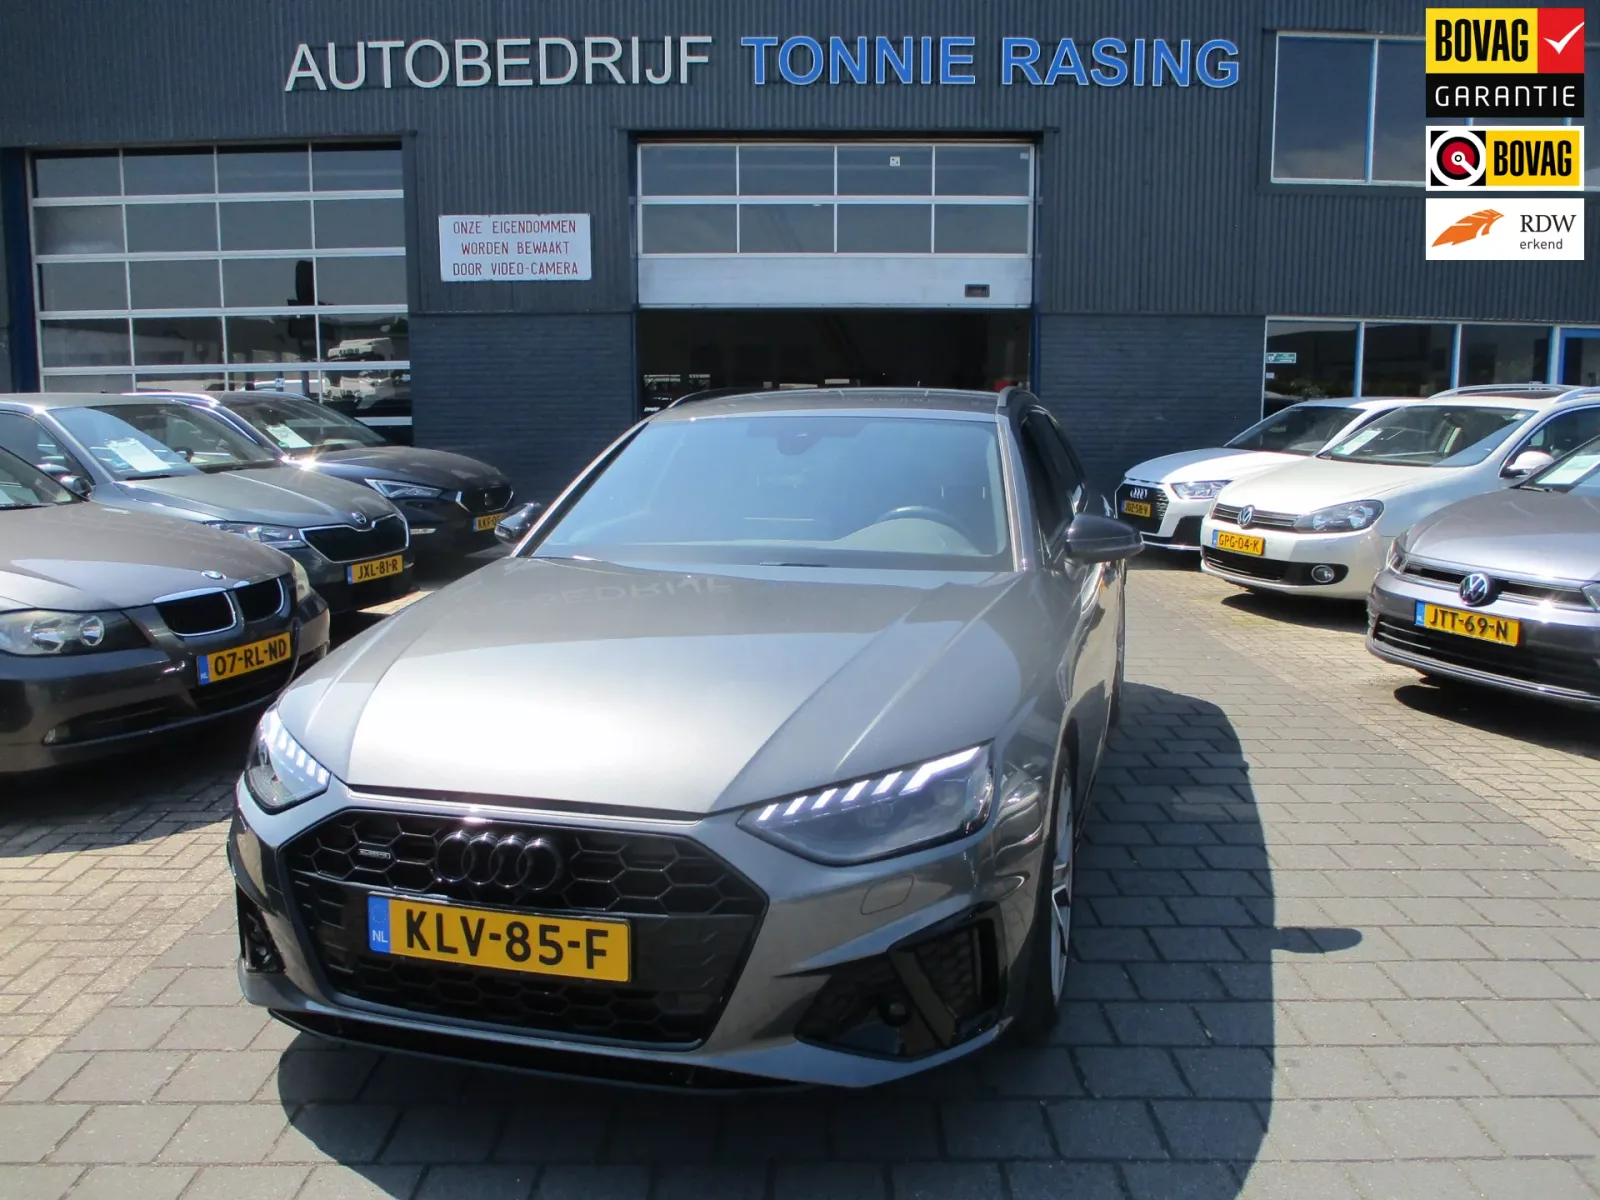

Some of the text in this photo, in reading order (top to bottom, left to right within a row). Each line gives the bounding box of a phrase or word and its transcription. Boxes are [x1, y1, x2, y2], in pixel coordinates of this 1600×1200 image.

[285, 36, 1240, 91] AUTOBEDRIJF TONNIE RASING
[453, 220, 576, 234] ONZE EIGENDOMMEN
[461, 241, 570, 255] WORDEN BEWAAKT
[453, 261, 579, 276] DOOR VIDEO-CAMERA
[1218, 533, 1260, 553] GPG-04-K
[357, 558, 399, 580] JXL-81-R
[1429, 608, 1508, 640] JTT-69-N
[214, 638, 287, 676] 07-RL-ND
[372, 908, 608, 970] NL KLV-85-F
